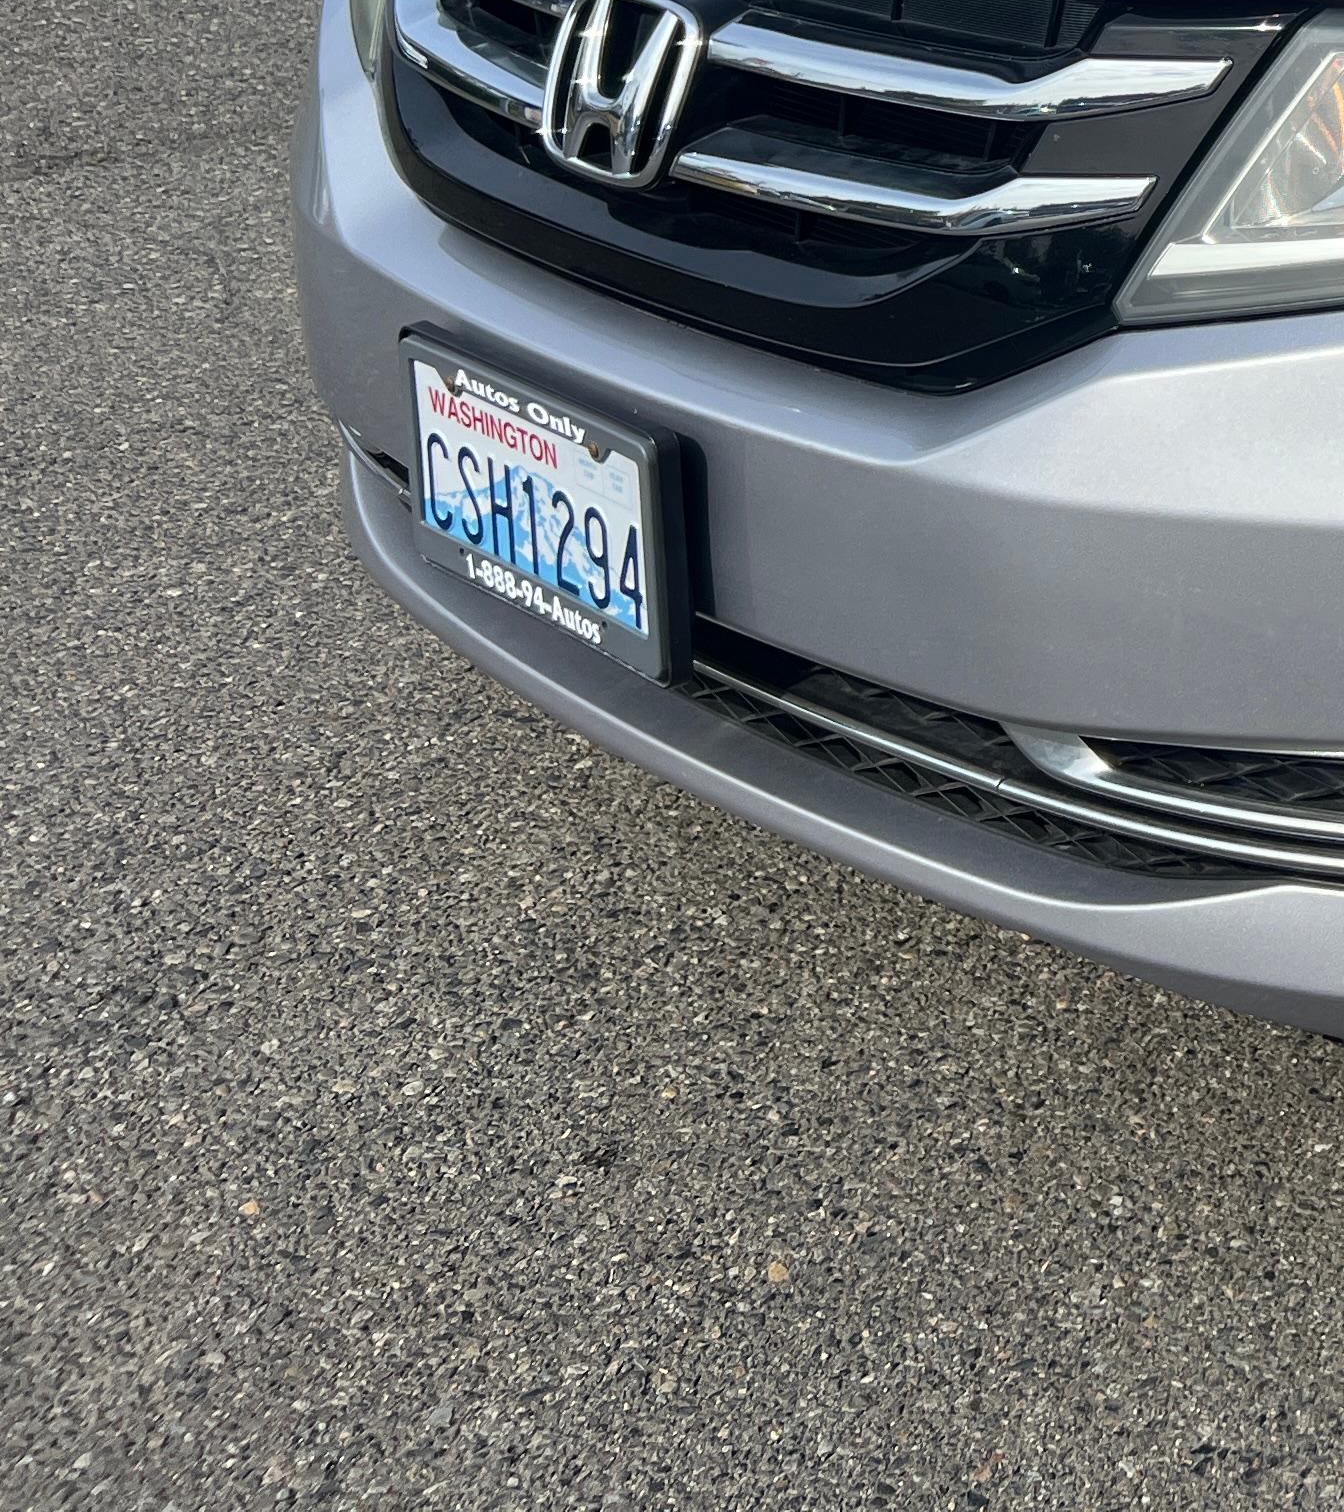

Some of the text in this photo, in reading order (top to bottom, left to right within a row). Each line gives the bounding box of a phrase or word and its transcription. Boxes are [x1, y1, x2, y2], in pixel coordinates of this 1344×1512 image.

[428, 386, 559, 470] WASHINGTON
[454, 368, 587, 444] Autos Only
[426, 432, 645, 630] CSH1294
[465, 553, 602, 645] 1-888-94-Autos
